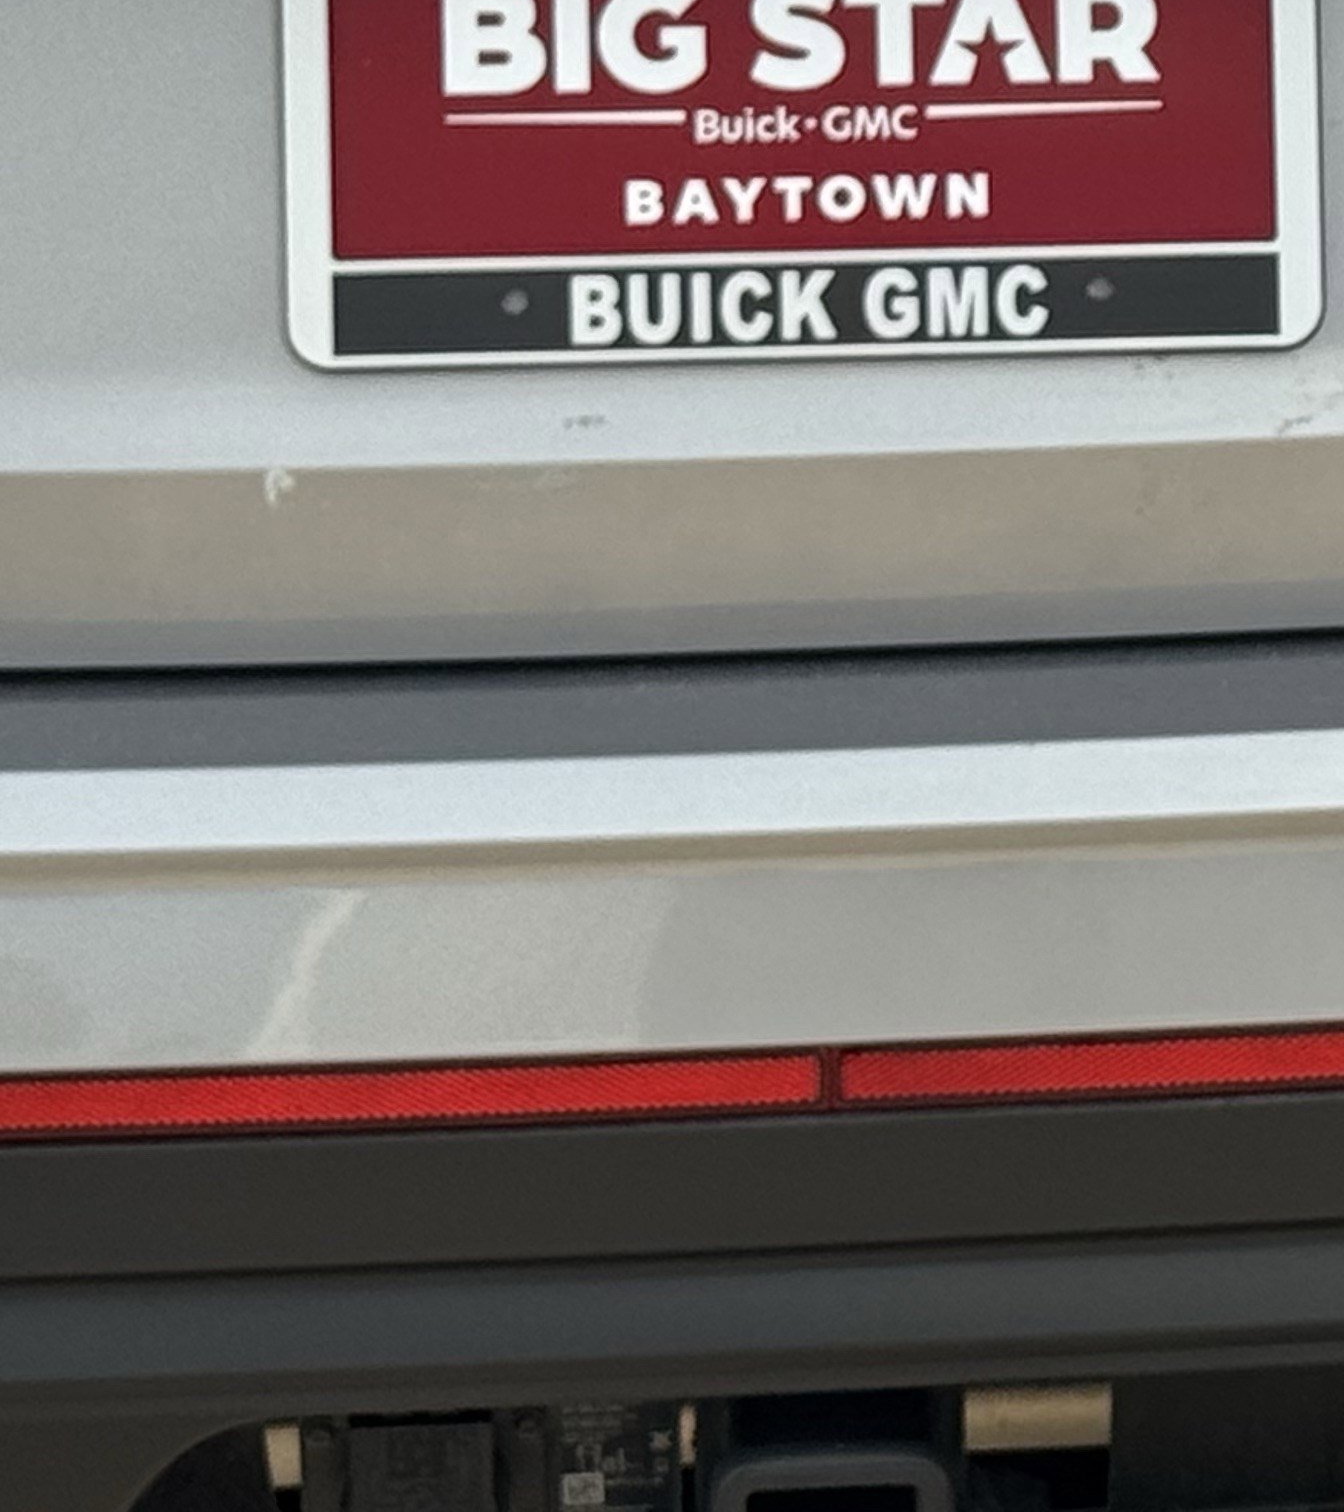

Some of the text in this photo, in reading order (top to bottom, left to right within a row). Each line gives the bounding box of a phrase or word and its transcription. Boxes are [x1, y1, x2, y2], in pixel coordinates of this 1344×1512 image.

[624, 172, 991, 227] BAYTOWN
[569, 264, 1050, 346] BUICK GMC
